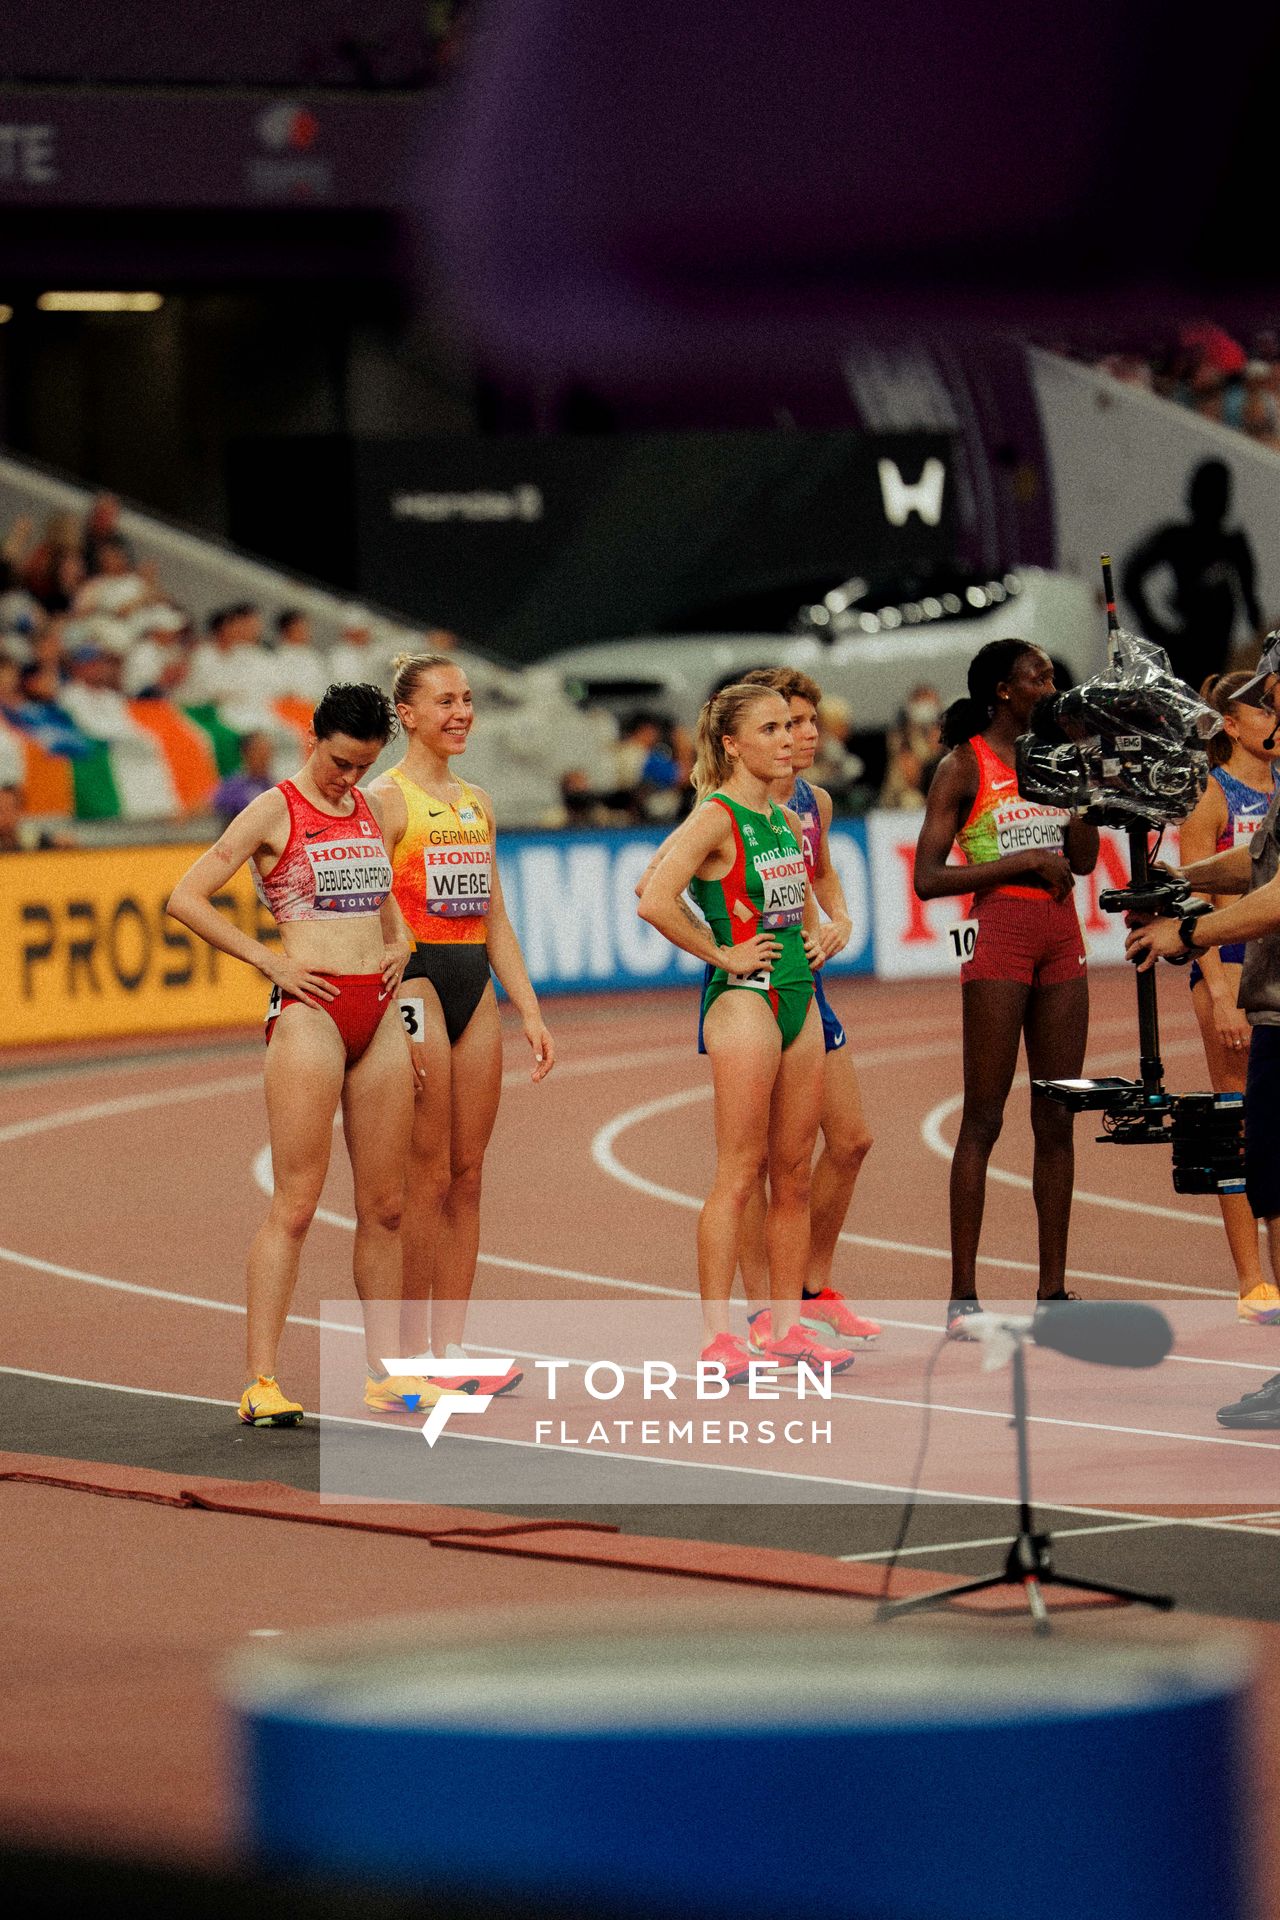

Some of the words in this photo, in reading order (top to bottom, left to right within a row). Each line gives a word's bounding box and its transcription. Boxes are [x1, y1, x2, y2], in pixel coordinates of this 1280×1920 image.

[310, 845, 385, 863] HONDA
[427, 851, 491, 866] HONDA
[340, 895, 380, 908] TOKYO
[949, 927, 976, 957] 10
